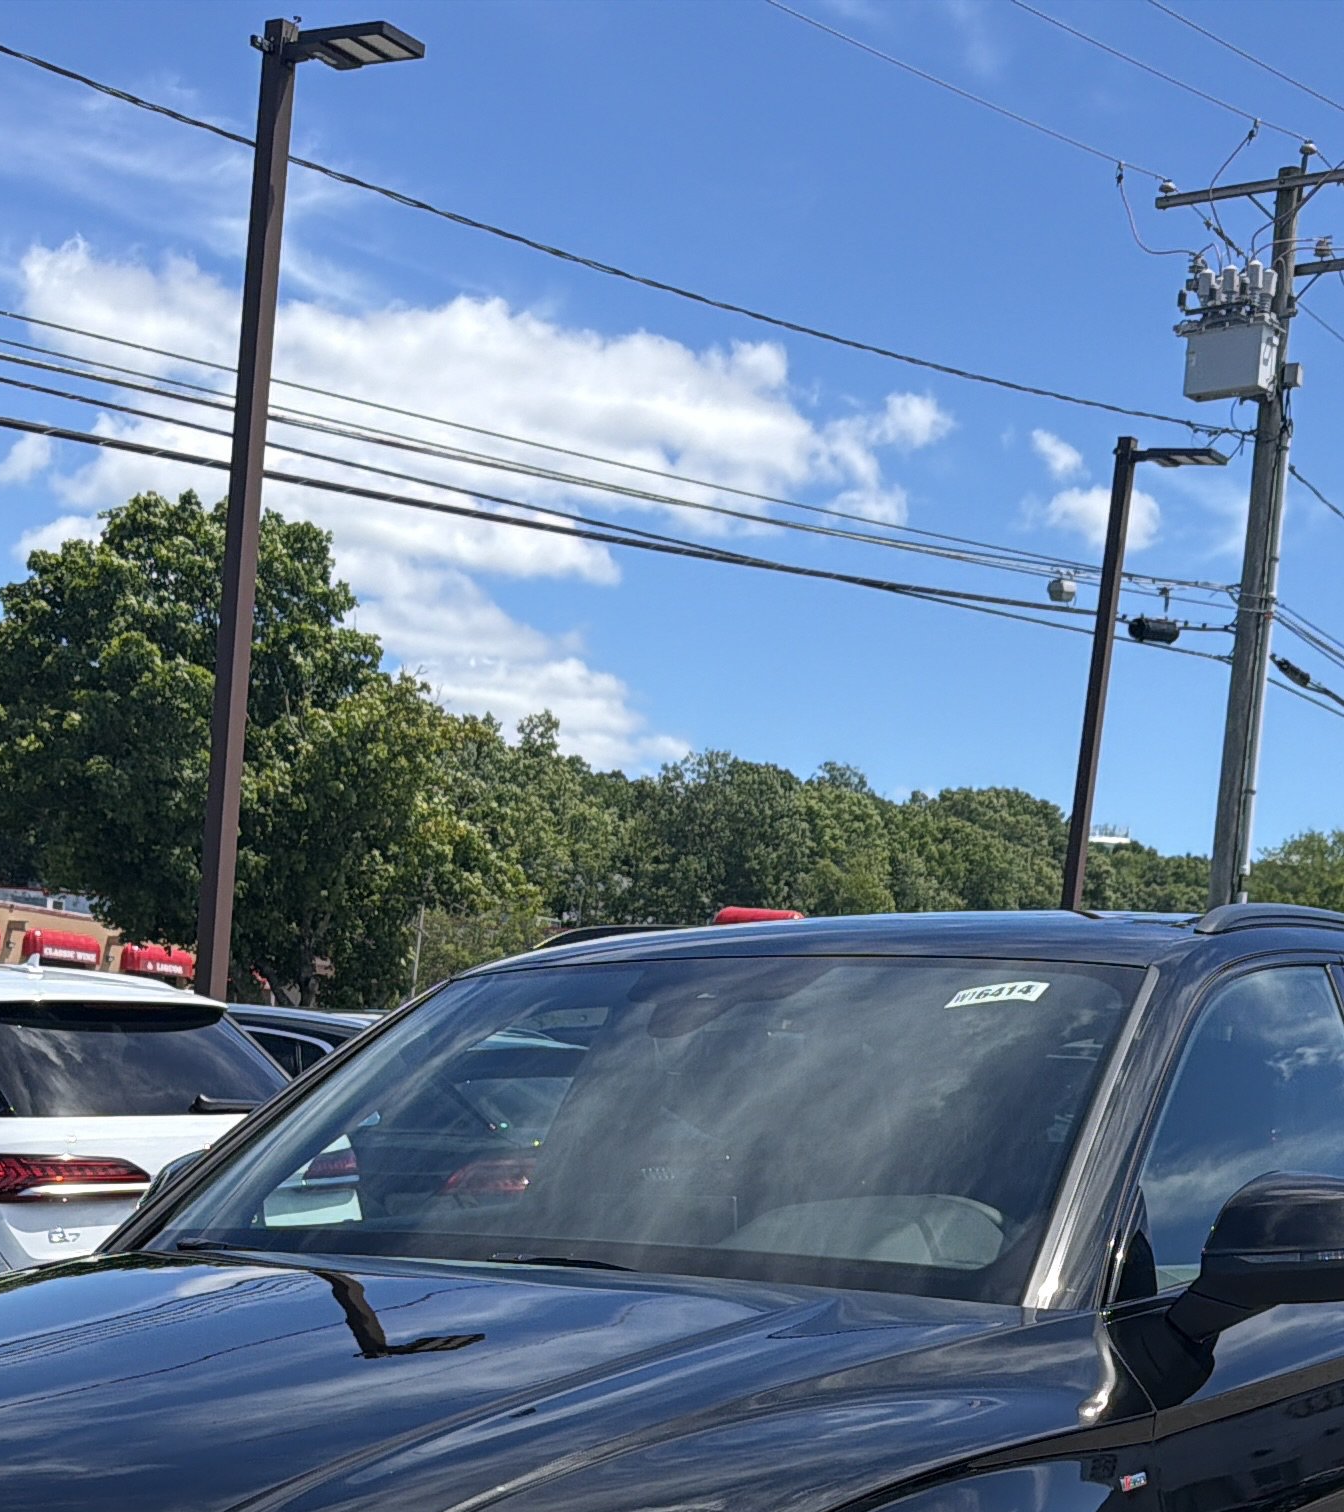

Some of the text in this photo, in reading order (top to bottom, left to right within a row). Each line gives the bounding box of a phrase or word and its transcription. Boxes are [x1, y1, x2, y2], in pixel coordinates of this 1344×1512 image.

[43, 947, 97, 961] CLASSIC WINE
[47, 1224, 81, 1244] Q7
